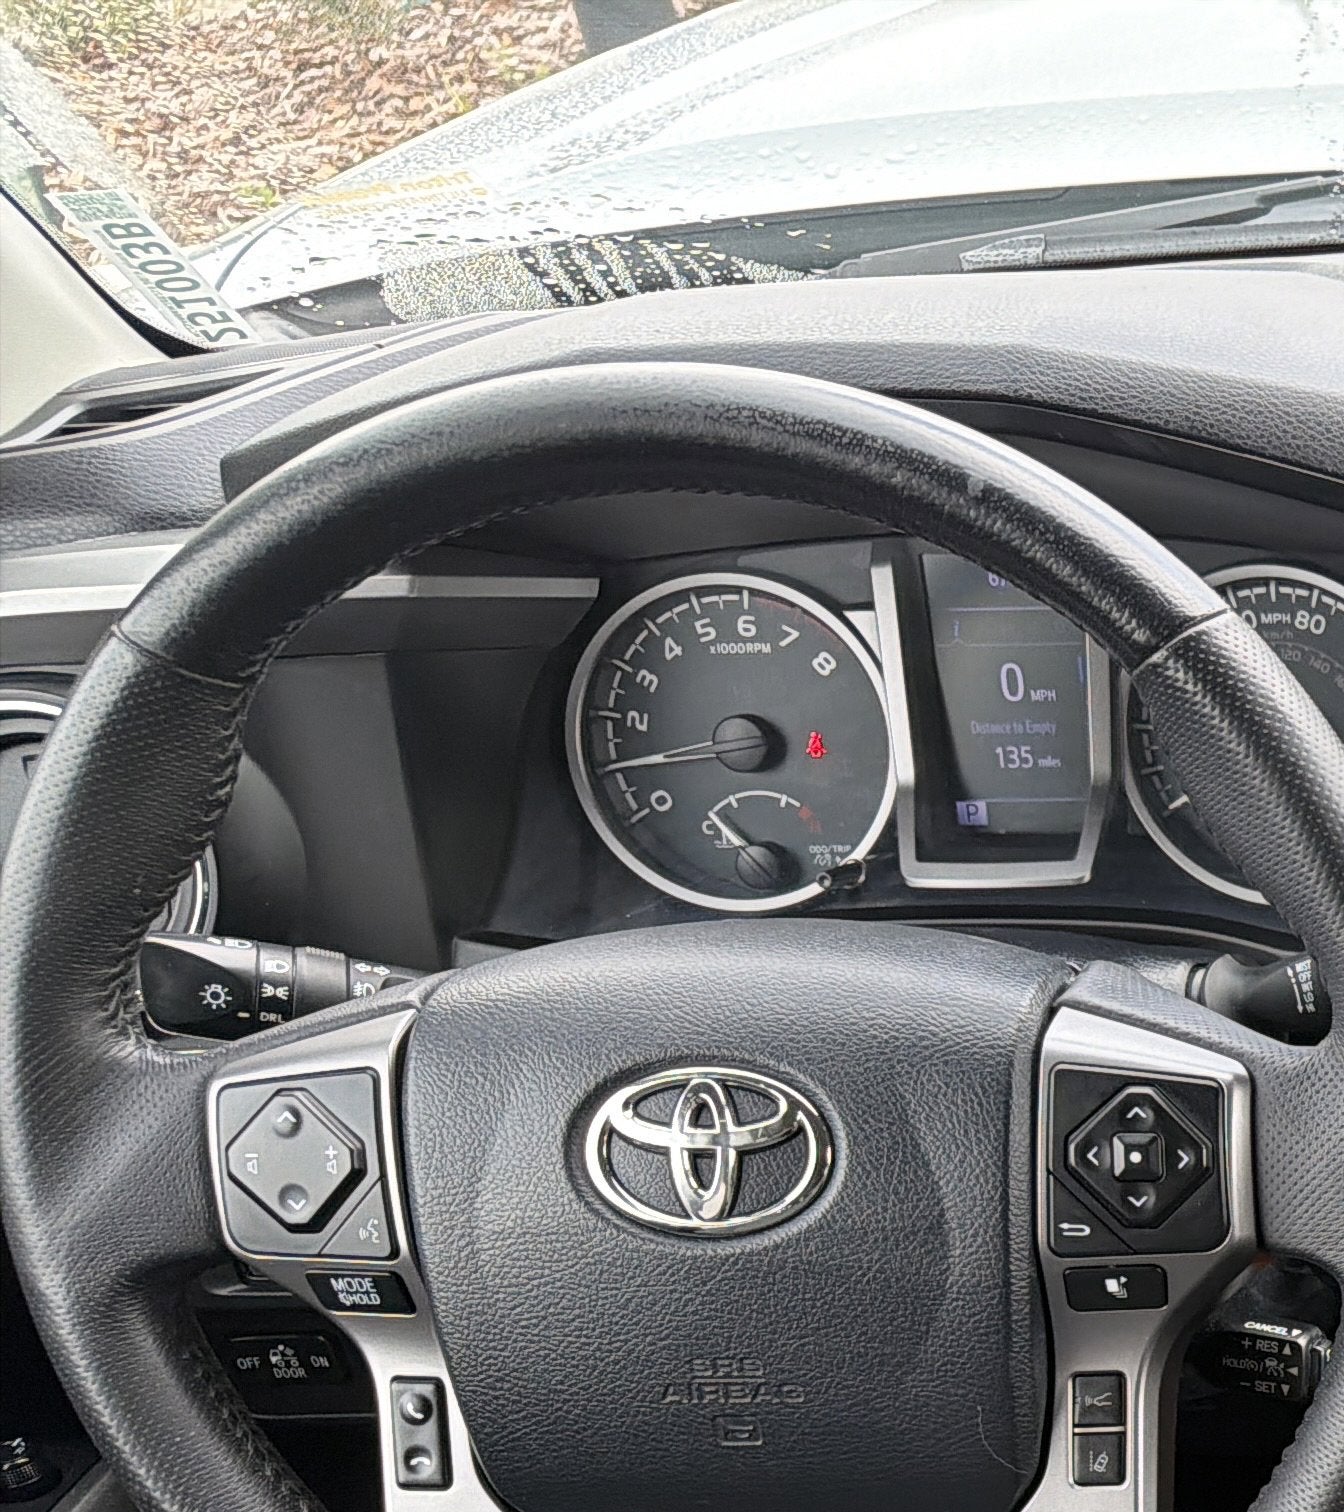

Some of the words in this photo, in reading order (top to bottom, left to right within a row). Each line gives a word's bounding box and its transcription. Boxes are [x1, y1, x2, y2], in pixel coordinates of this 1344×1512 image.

[737, 615, 757, 637] 6
[1261, 612, 1291, 624] MPH
[1294, 610, 1326, 635] 80
[694, 618, 716, 643] 5
[778, 625, 800, 647] 7
[664, 636, 683, 661] 4
[811, 651, 837, 676] 8
[635, 668, 659, 693] 3
[1000, 662, 1025, 702] 0
[1030, 690, 1057, 702] MPH
[626, 711, 648, 732] 2
[971, 720, 1011, 735] Distance
[1013, 721, 1024, 734] to
[995, 746, 1034, 769] 135
[650, 789, 673, 812] 0
[966, 804, 979, 823] P
[259, 1012, 286, 1023] DRL
[330, 1277, 377, 1292] MODE
[1244, 1321, 1288, 1336] CANCEL
[237, 1357, 261, 1369] OFF
[310, 1356, 330, 1367] ON
[273, 1368, 307, 1378] DOOR
